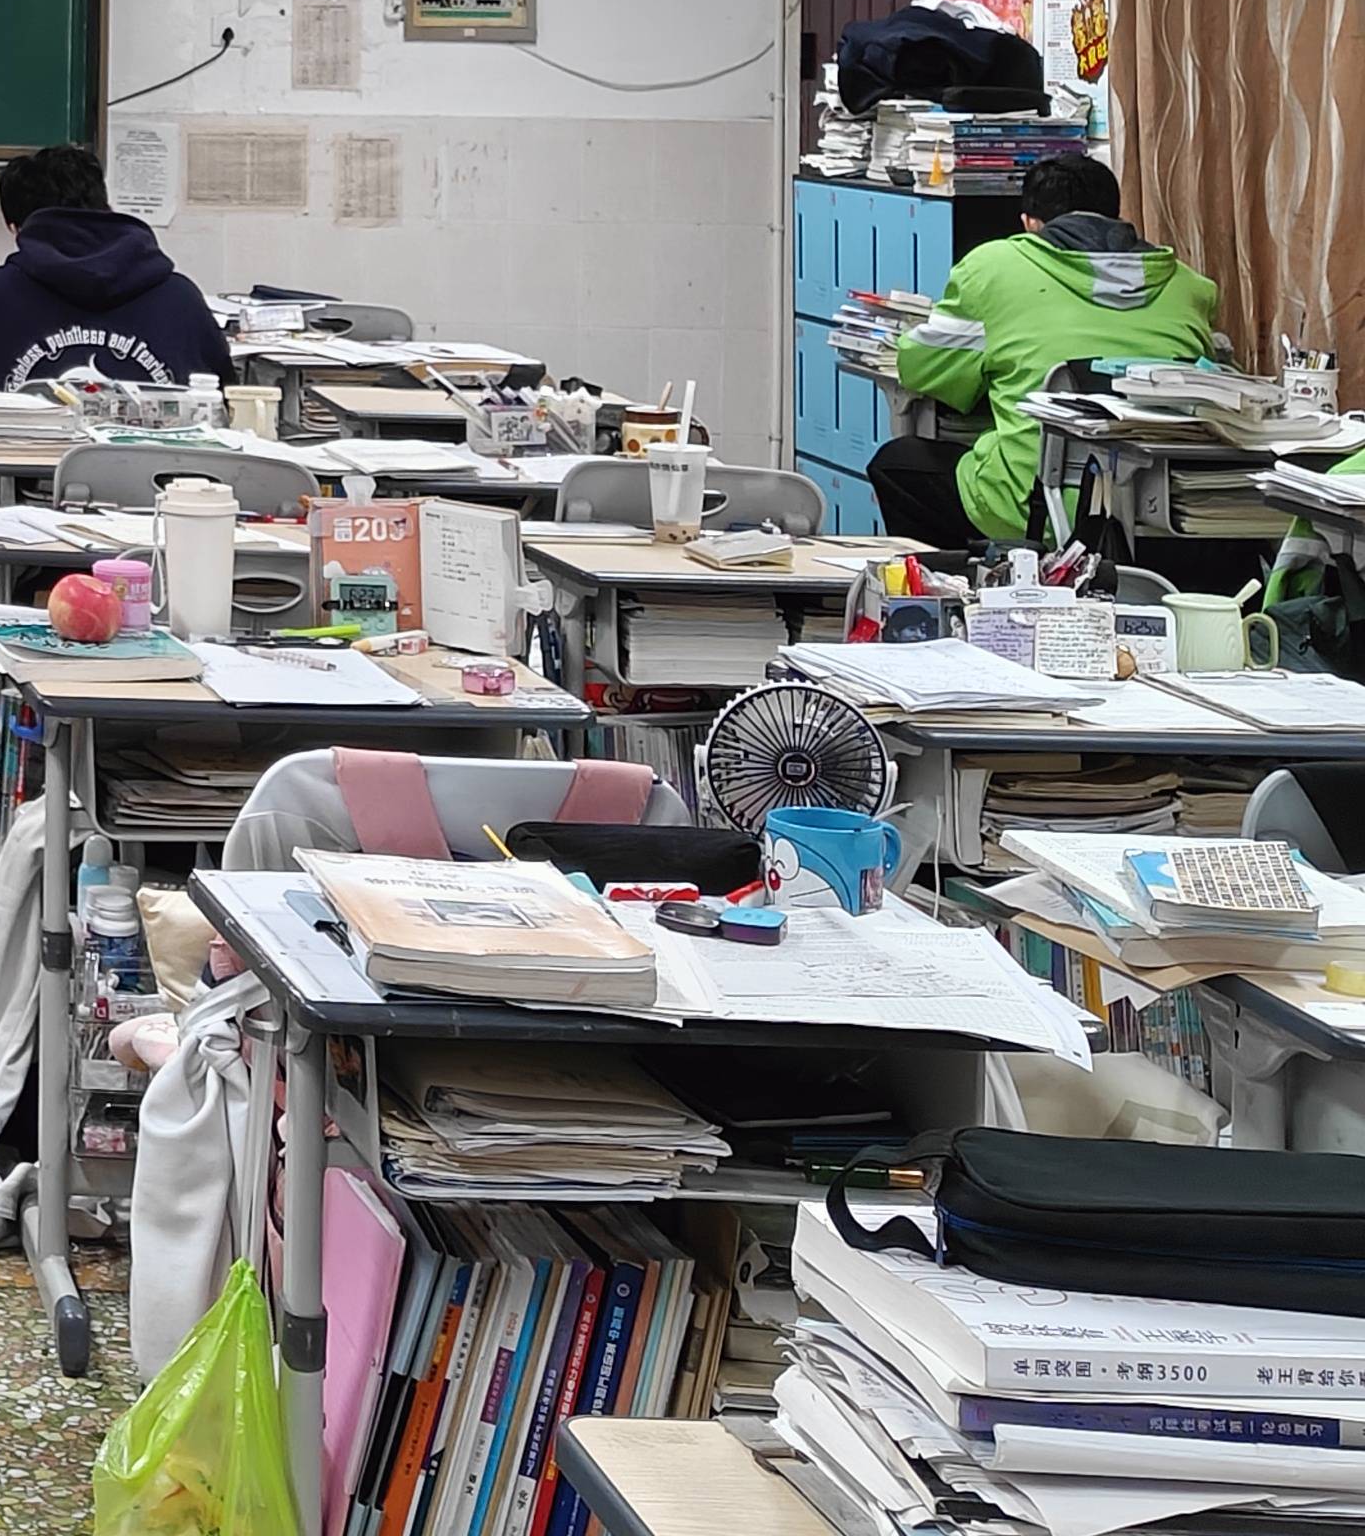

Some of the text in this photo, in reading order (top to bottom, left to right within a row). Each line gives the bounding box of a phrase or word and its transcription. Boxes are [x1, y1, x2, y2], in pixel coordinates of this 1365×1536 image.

[1149, 1413, 1325, 1439] 选择性考试第一轮总复习
